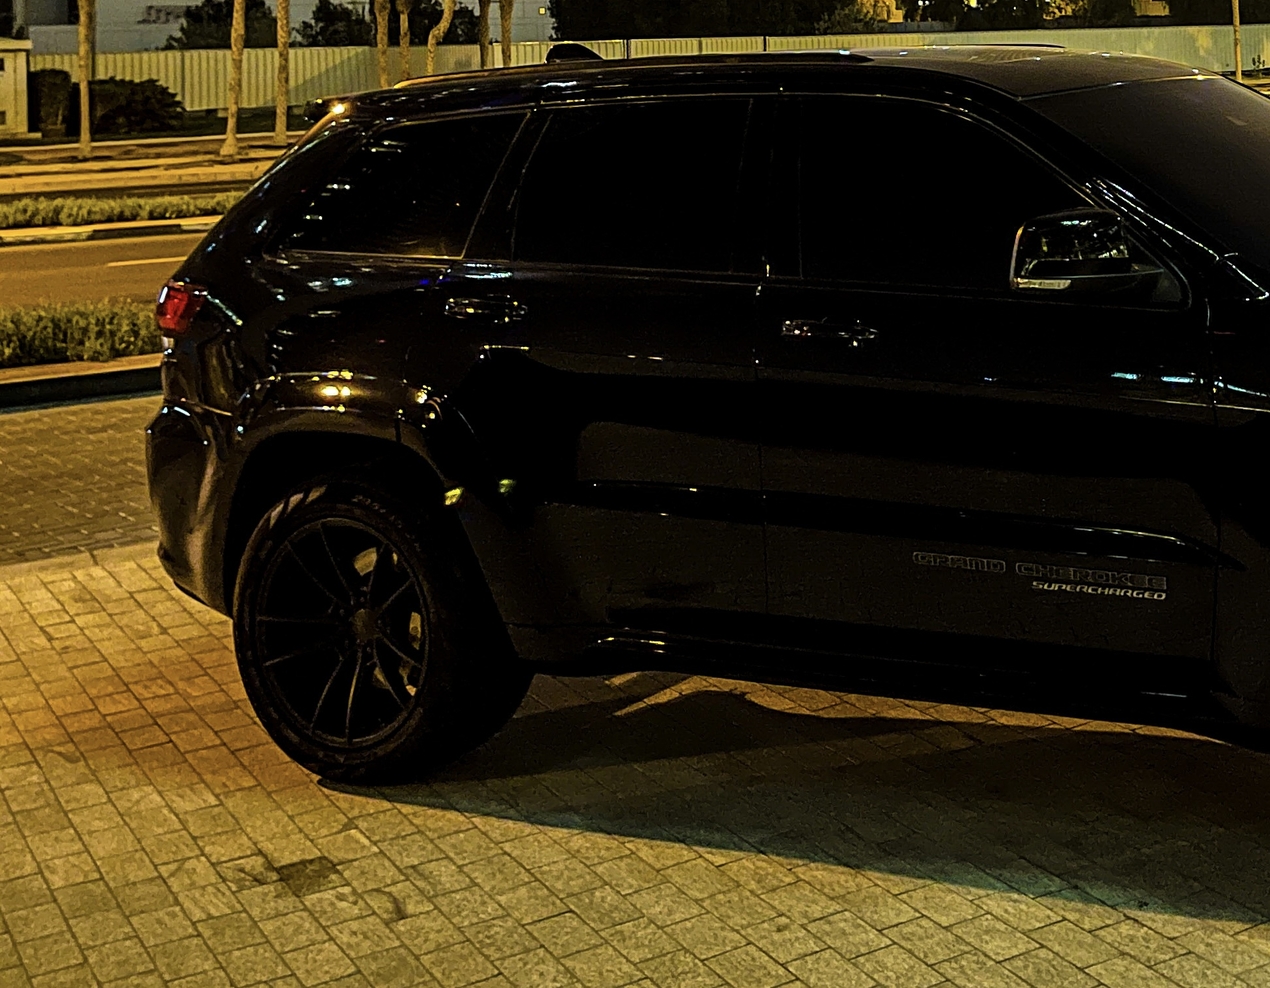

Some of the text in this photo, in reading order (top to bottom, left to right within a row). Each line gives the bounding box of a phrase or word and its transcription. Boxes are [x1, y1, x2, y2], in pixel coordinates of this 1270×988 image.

[912, 552, 1168, 590] GRAND CHEROKEE
[1031, 580, 1167, 601] SUPERCHARGED
